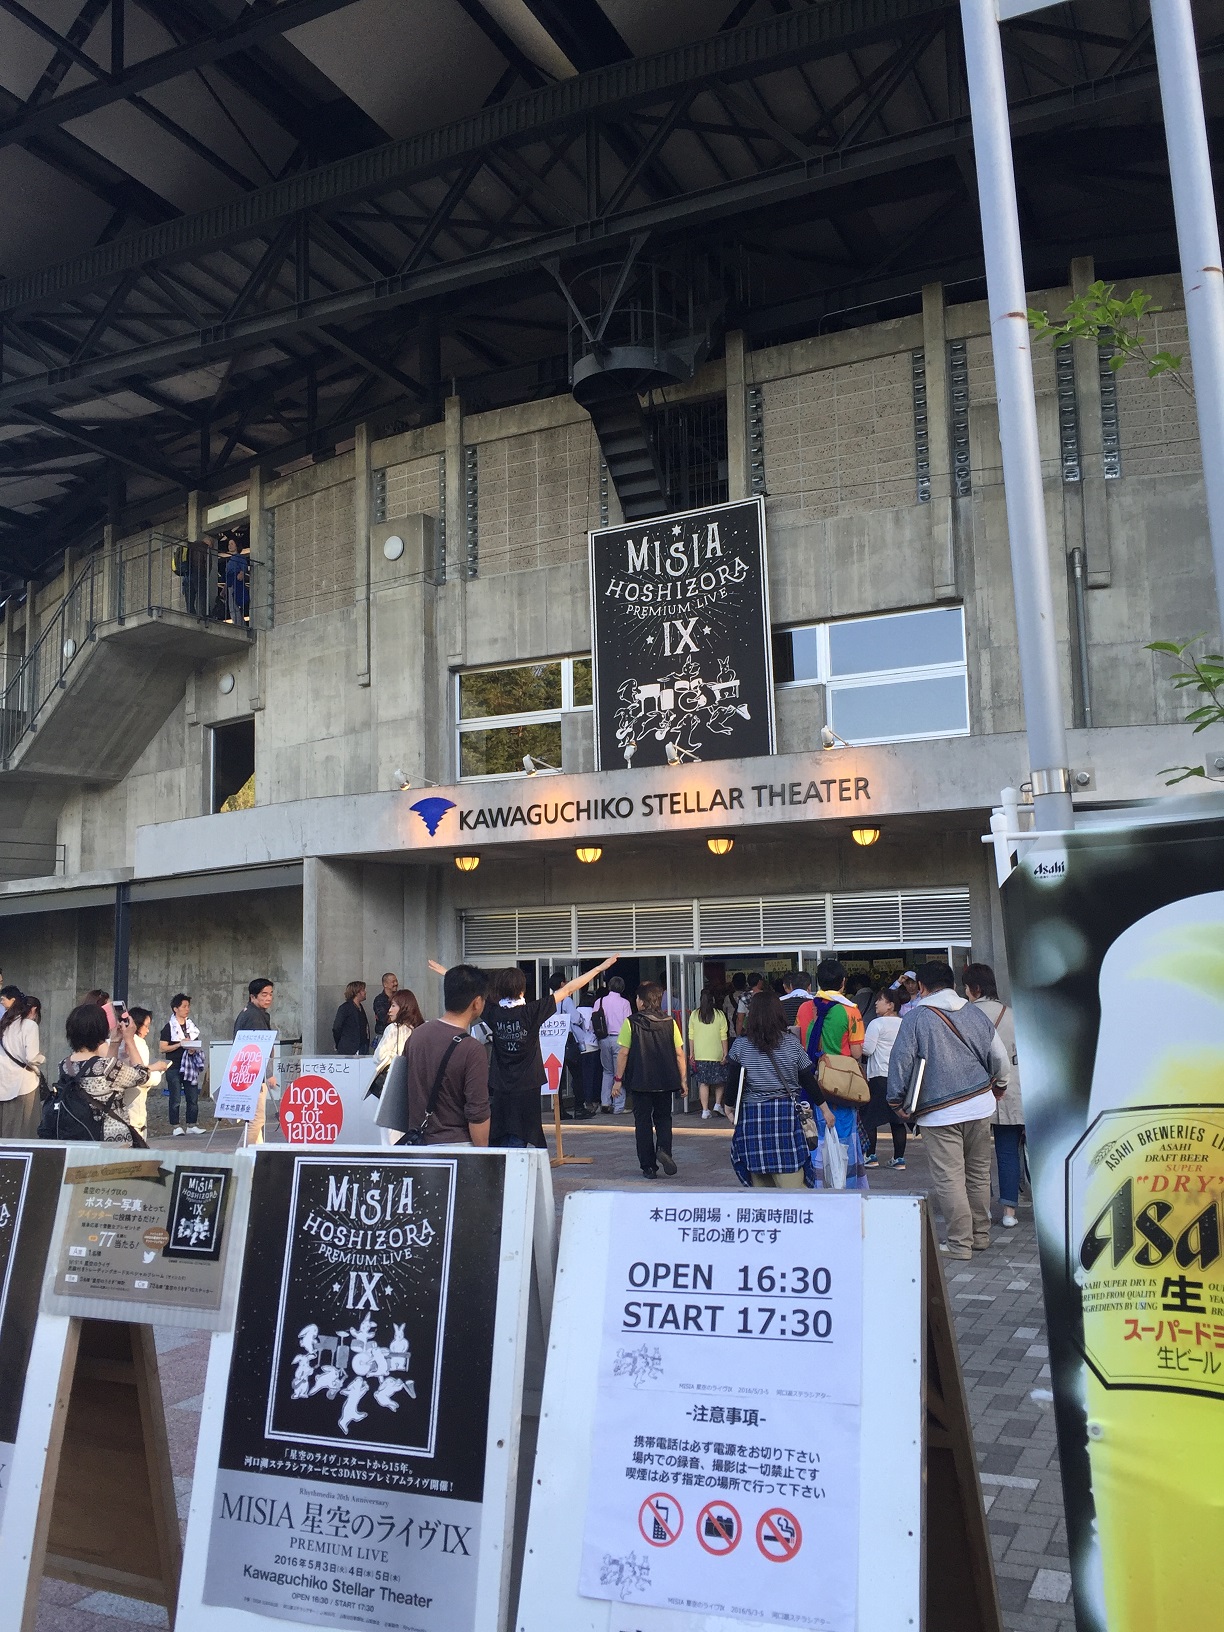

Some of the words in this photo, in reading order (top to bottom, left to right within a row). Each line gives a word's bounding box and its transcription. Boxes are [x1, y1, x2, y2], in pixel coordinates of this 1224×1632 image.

[627, 522, 723, 577] MISIA
[605, 557, 749, 602] HOSHIZORA
[626, 602, 692, 619] PREMIUM
[696, 587, 728, 608] LIVE
[663, 617, 700, 656] IX
[459, 796, 634, 831] KAWAGUCHIKO
[642, 787, 744, 817] STELLAR
[752, 777, 870, 806] THEATER
[1034, 861, 1064, 875] Asahi
[507, 1042, 517, 1051] IX
[237, 1051, 262, 1066] hope
[240, 1064, 252, 1073] for
[277, 1062, 350, 1074] 私たちにできること
[230, 1066, 256, 1086] japan
[288, 1082, 339, 1110] hope
[301, 1104, 324, 1124] for
[285, 1111, 338, 1144] japan
[1105, 1140, 1134, 1172] ASAHI
[1137, 1125, 1206, 1146] BREWERIES
[1212, 1133, 1224, 1152] LI
[1145, 1154, 1178, 1162] DRAFT
[1180, 1154, 1209, 1162] BEER
[1165, 1164, 1203, 1172] SUPER
[182, 1188, 218, 1200] HOSHIZORA
[188, 1178, 214, 1192] MISIA
[193, 1204, 204, 1215] IX
[326, 1175, 413, 1226] MISIA
[650, 1207, 814, 1224] 本日の開場・開演時間は
[1079, 1176, 1224, 1272] Asa
[98, 1231, 116, 1248] 77
[302, 1212, 436, 1250] HOSHIZORA
[678, 1227, 782, 1244] 下記の通りです
[318, 1243, 378, 1266] PREMIUM
[382, 1248, 412, 1266] LIVE
[628, 1262, 714, 1290] OPEN
[738, 1266, 832, 1294] 16:30
[1082, 1280, 1101, 1290] SAHI
[1103, 1279, 1128, 1288] SUPER
[1130, 1278, 1148, 1286] DRY
[1148, 1278, 1158, 1286] IS
[1208, 1283, 1224, 1292] OU
[346, 1271, 384, 1312] IX
[1082, 1292, 1106, 1302] REWED
[1106, 1290, 1126, 1300] FROM
[1127, 1290, 1157, 1300] QUALITY
[1160, 1275, 1206, 1314] 生
[1082, 1302, 1124, 1313] NGREDIENTS
[1135, 1302, 1158, 1310] USING
[1211, 1307, 1224, 1316] BR
[622, 1302, 724, 1332] START
[737, 1307, 833, 1338] 17:30
[1157, 1346, 1222, 1374] 生ビール
[686, 1404, 766, 1427] -注意事項-
[633, 1435, 820, 1464] 携帯電話は必ず電源をお切り下さい
[284, 1448, 414, 1475] 「星空のライヴ」スタートから15年。
[632, 1451, 820, 1482] 場内での録音、撮影は一切禁止です
[625, 1467, 826, 1499] 喫煙は必ず指定の場所で行って下さい
[300, 1487, 336, 1500] Rhythmedia
[336, 1492, 350, 1502] 20th
[350, 1495, 390, 1508] Anniversary
[219, 1492, 295, 1530] MISIA
[300, 1501, 473, 1557] 星空のライヴIX
[290, 1536, 354, 1558] PREMIUM
[357, 1548, 389, 1564] LIVE
[243, 1564, 328, 1591] Kawaguchiko
[332, 1579, 375, 1598] Stellar
[379, 1587, 433, 1608] Theater
[292, 1592, 310, 1602] OPEN
[334, 1598, 356, 1609] START
[357, 1603, 374, 1612] 17:30
